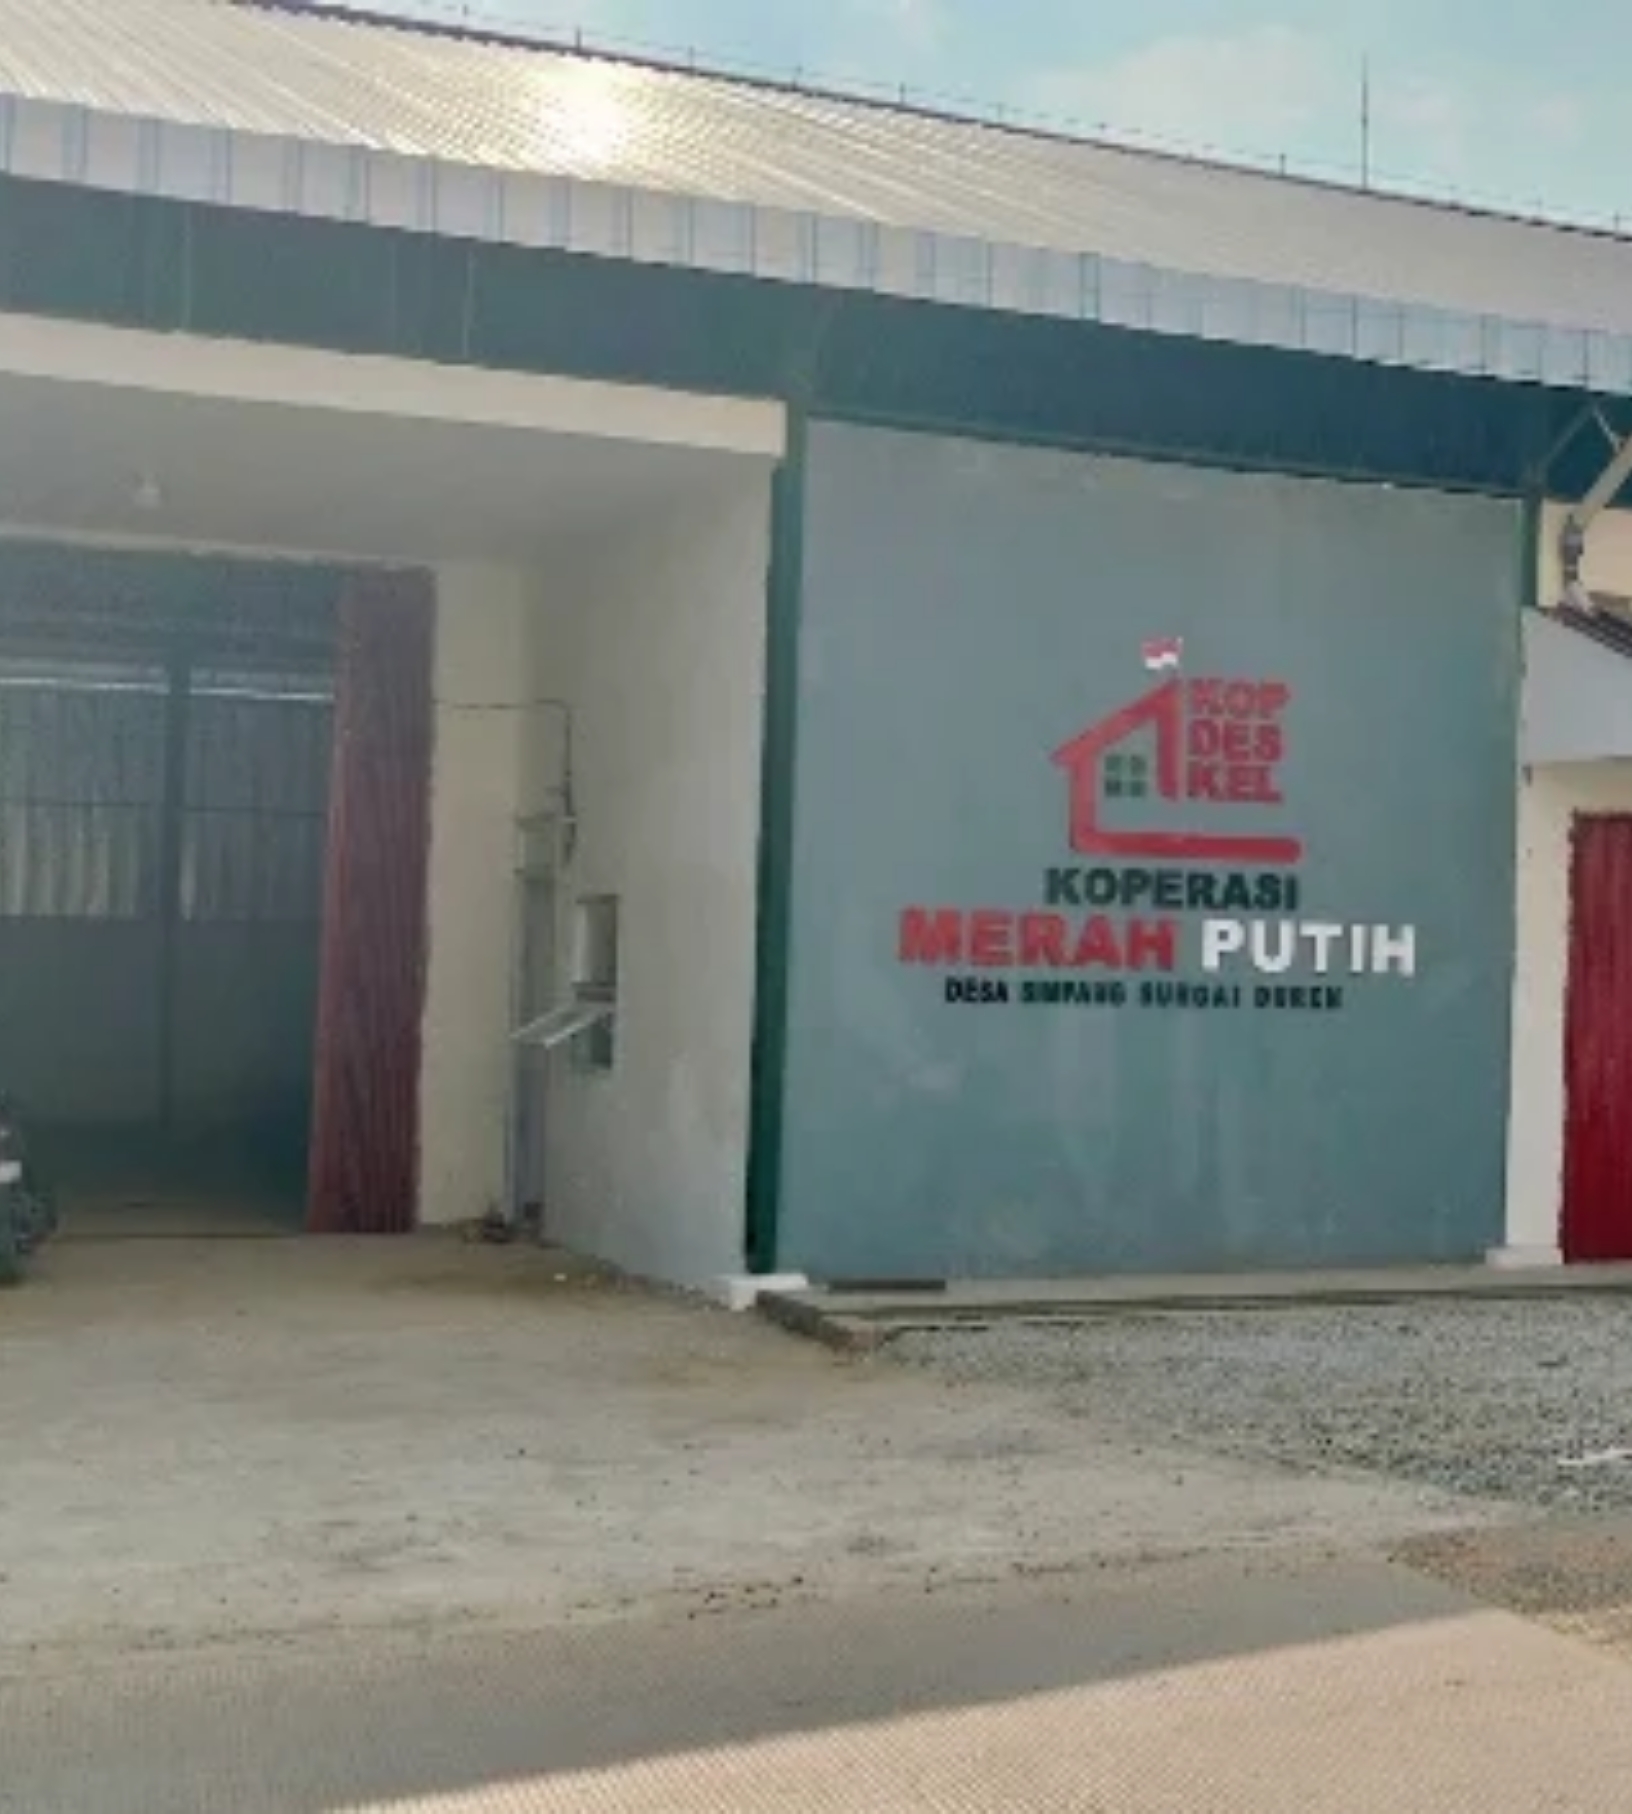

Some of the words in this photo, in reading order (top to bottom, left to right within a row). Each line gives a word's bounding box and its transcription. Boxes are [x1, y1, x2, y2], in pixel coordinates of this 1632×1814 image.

[1186, 678, 1290, 717] KOP
[1187, 721, 1282, 762] DES
[1186, 764, 1284, 804] KEL
[1044, 867, 1299, 911] KOPERASI
[897, 907, 1178, 971] MERAH
[1201, 918, 1416, 976] PUTIH
[944, 977, 1009, 1004] DESA
[1020, 980, 1127, 1007] SIMPANG
